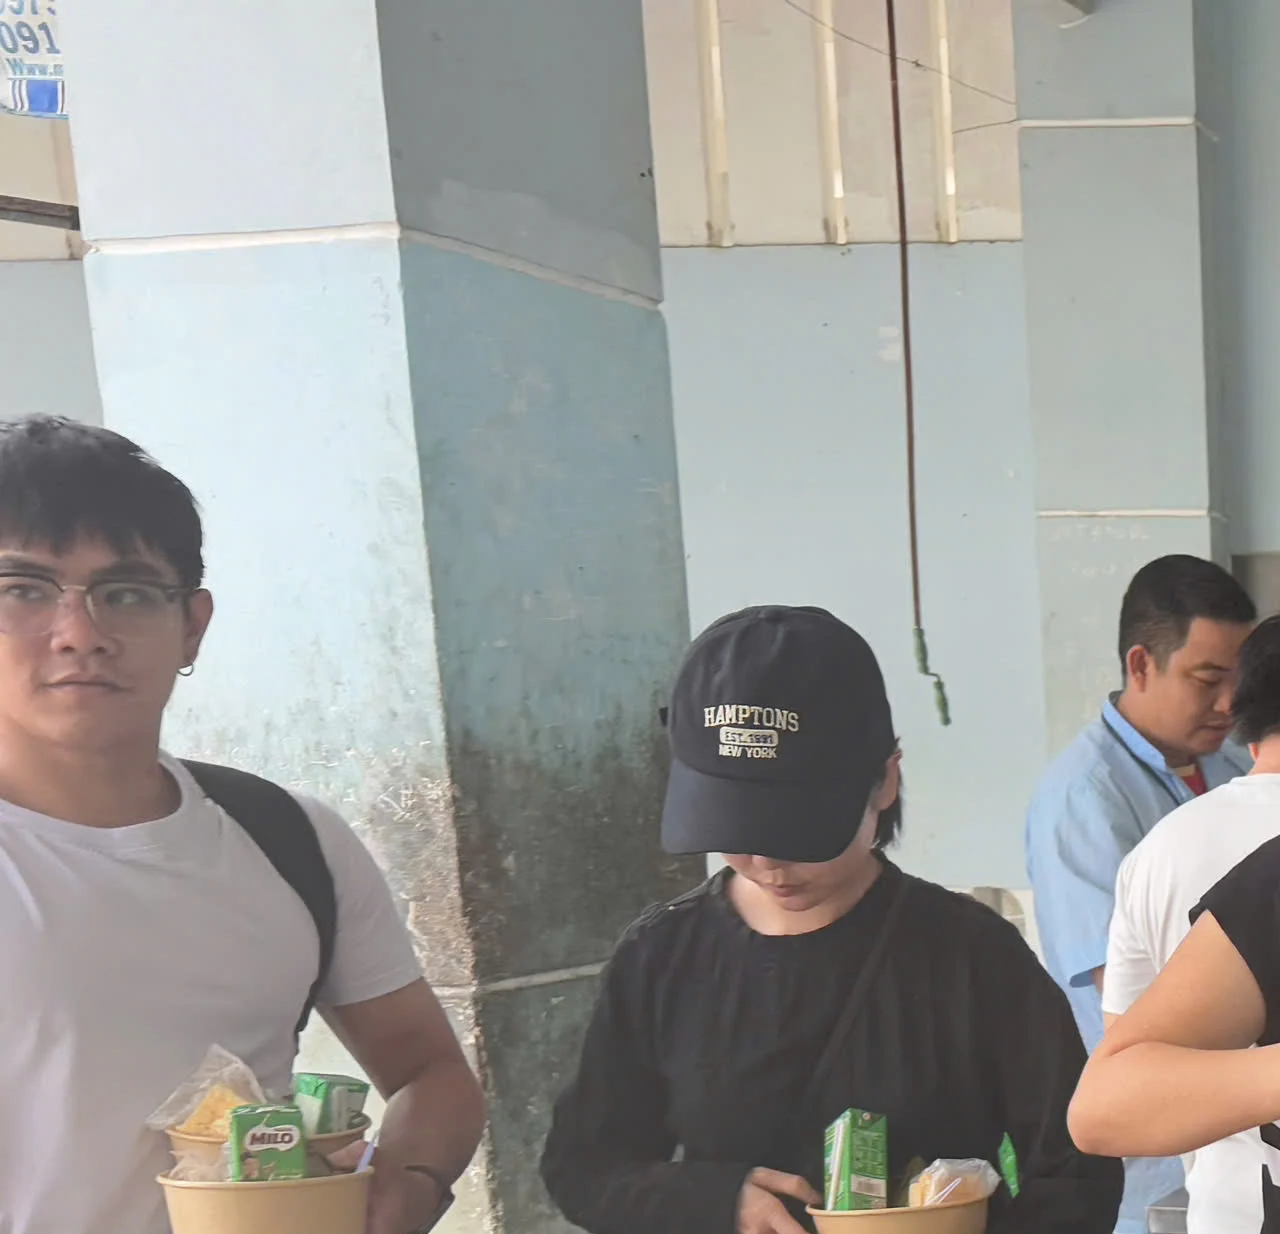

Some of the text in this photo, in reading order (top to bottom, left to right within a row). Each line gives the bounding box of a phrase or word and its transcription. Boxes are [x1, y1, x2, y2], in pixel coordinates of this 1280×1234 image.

[704, 704, 800, 732] HAMPTONS
[719, 744, 777, 759] NEW YORK
[250, 1131, 293, 1146] MILO
